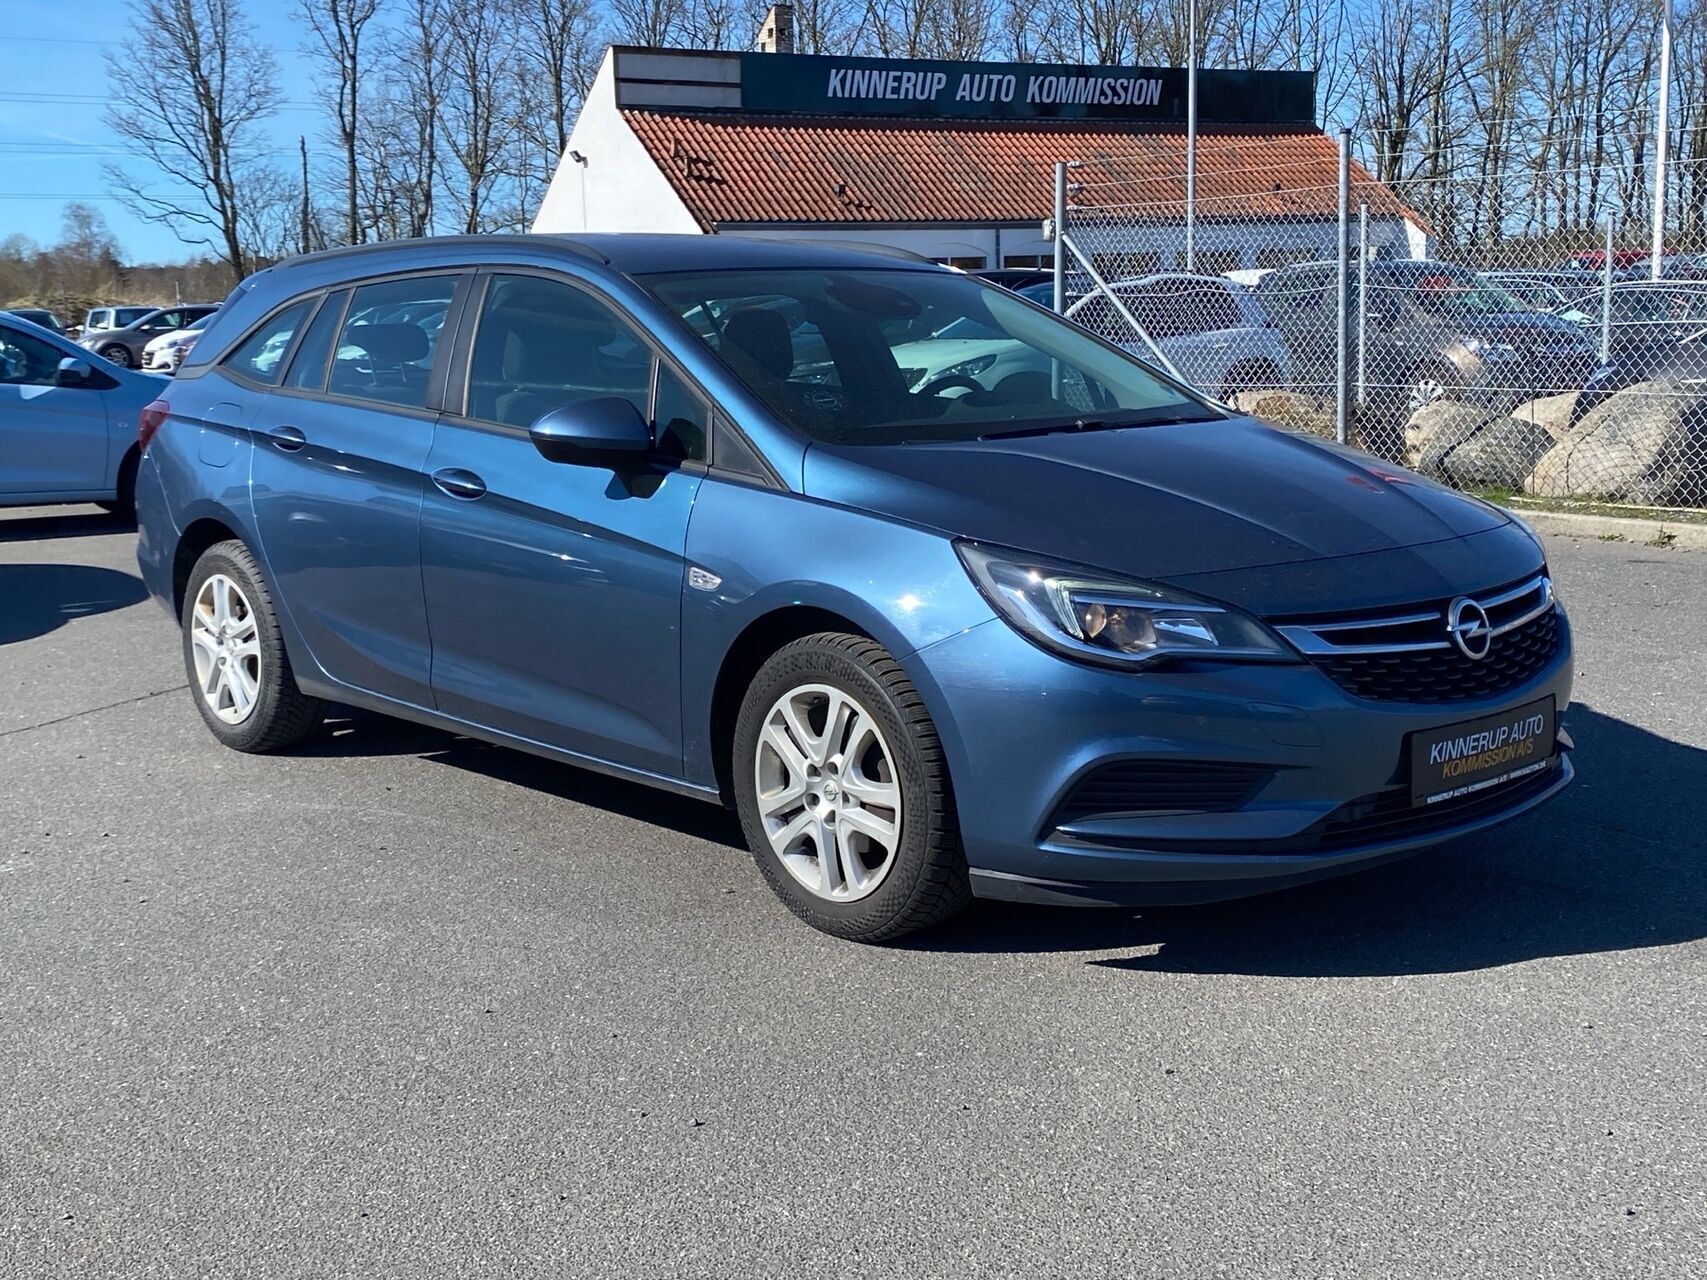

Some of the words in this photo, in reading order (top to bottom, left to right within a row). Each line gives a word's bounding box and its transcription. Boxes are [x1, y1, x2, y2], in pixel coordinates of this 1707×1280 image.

[827, 69, 946, 100] KINNERUP
[956, 73, 1016, 102] AUTO
[1026, 76, 1163, 106] KOMMISSION
[1430, 726, 1508, 764] KINNERUP
[1509, 714, 1543, 743] AUTO
[1442, 744, 1517, 778] KOMMISSION
[1515, 738, 1533, 759] A/S
